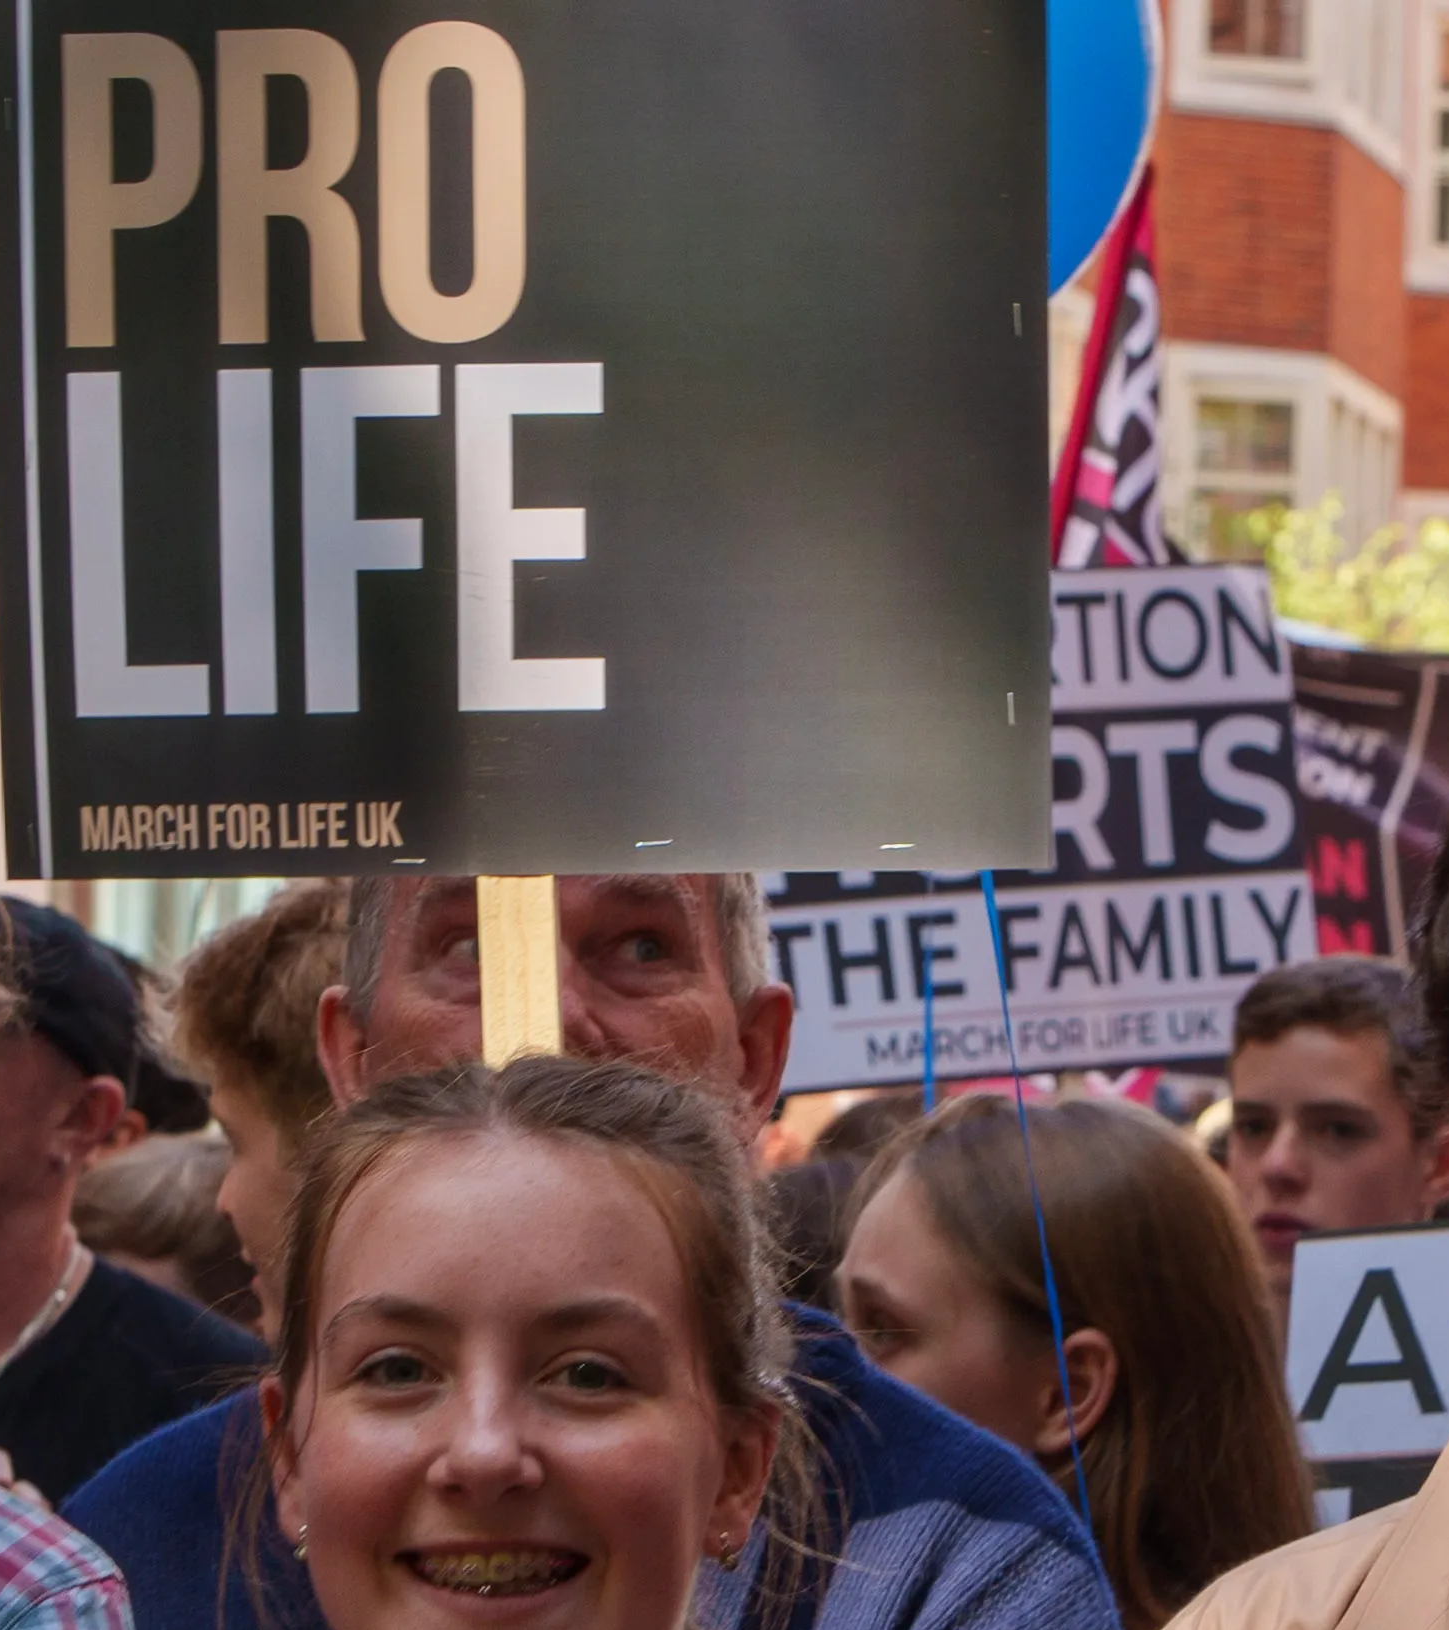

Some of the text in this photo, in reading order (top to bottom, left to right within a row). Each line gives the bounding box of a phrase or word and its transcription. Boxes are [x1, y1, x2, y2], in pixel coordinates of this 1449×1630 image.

[61, 20, 527, 349] PRO
[65, 362, 606, 719] LIFE
[1051, 586, 1282, 684] TION
[79, 800, 406, 852] MARCH FOR LIFE UK
[769, 886, 1302, 1011] THE FAMILY
[865, 1007, 1220, 1067] MARCH FOR LIFE UK
